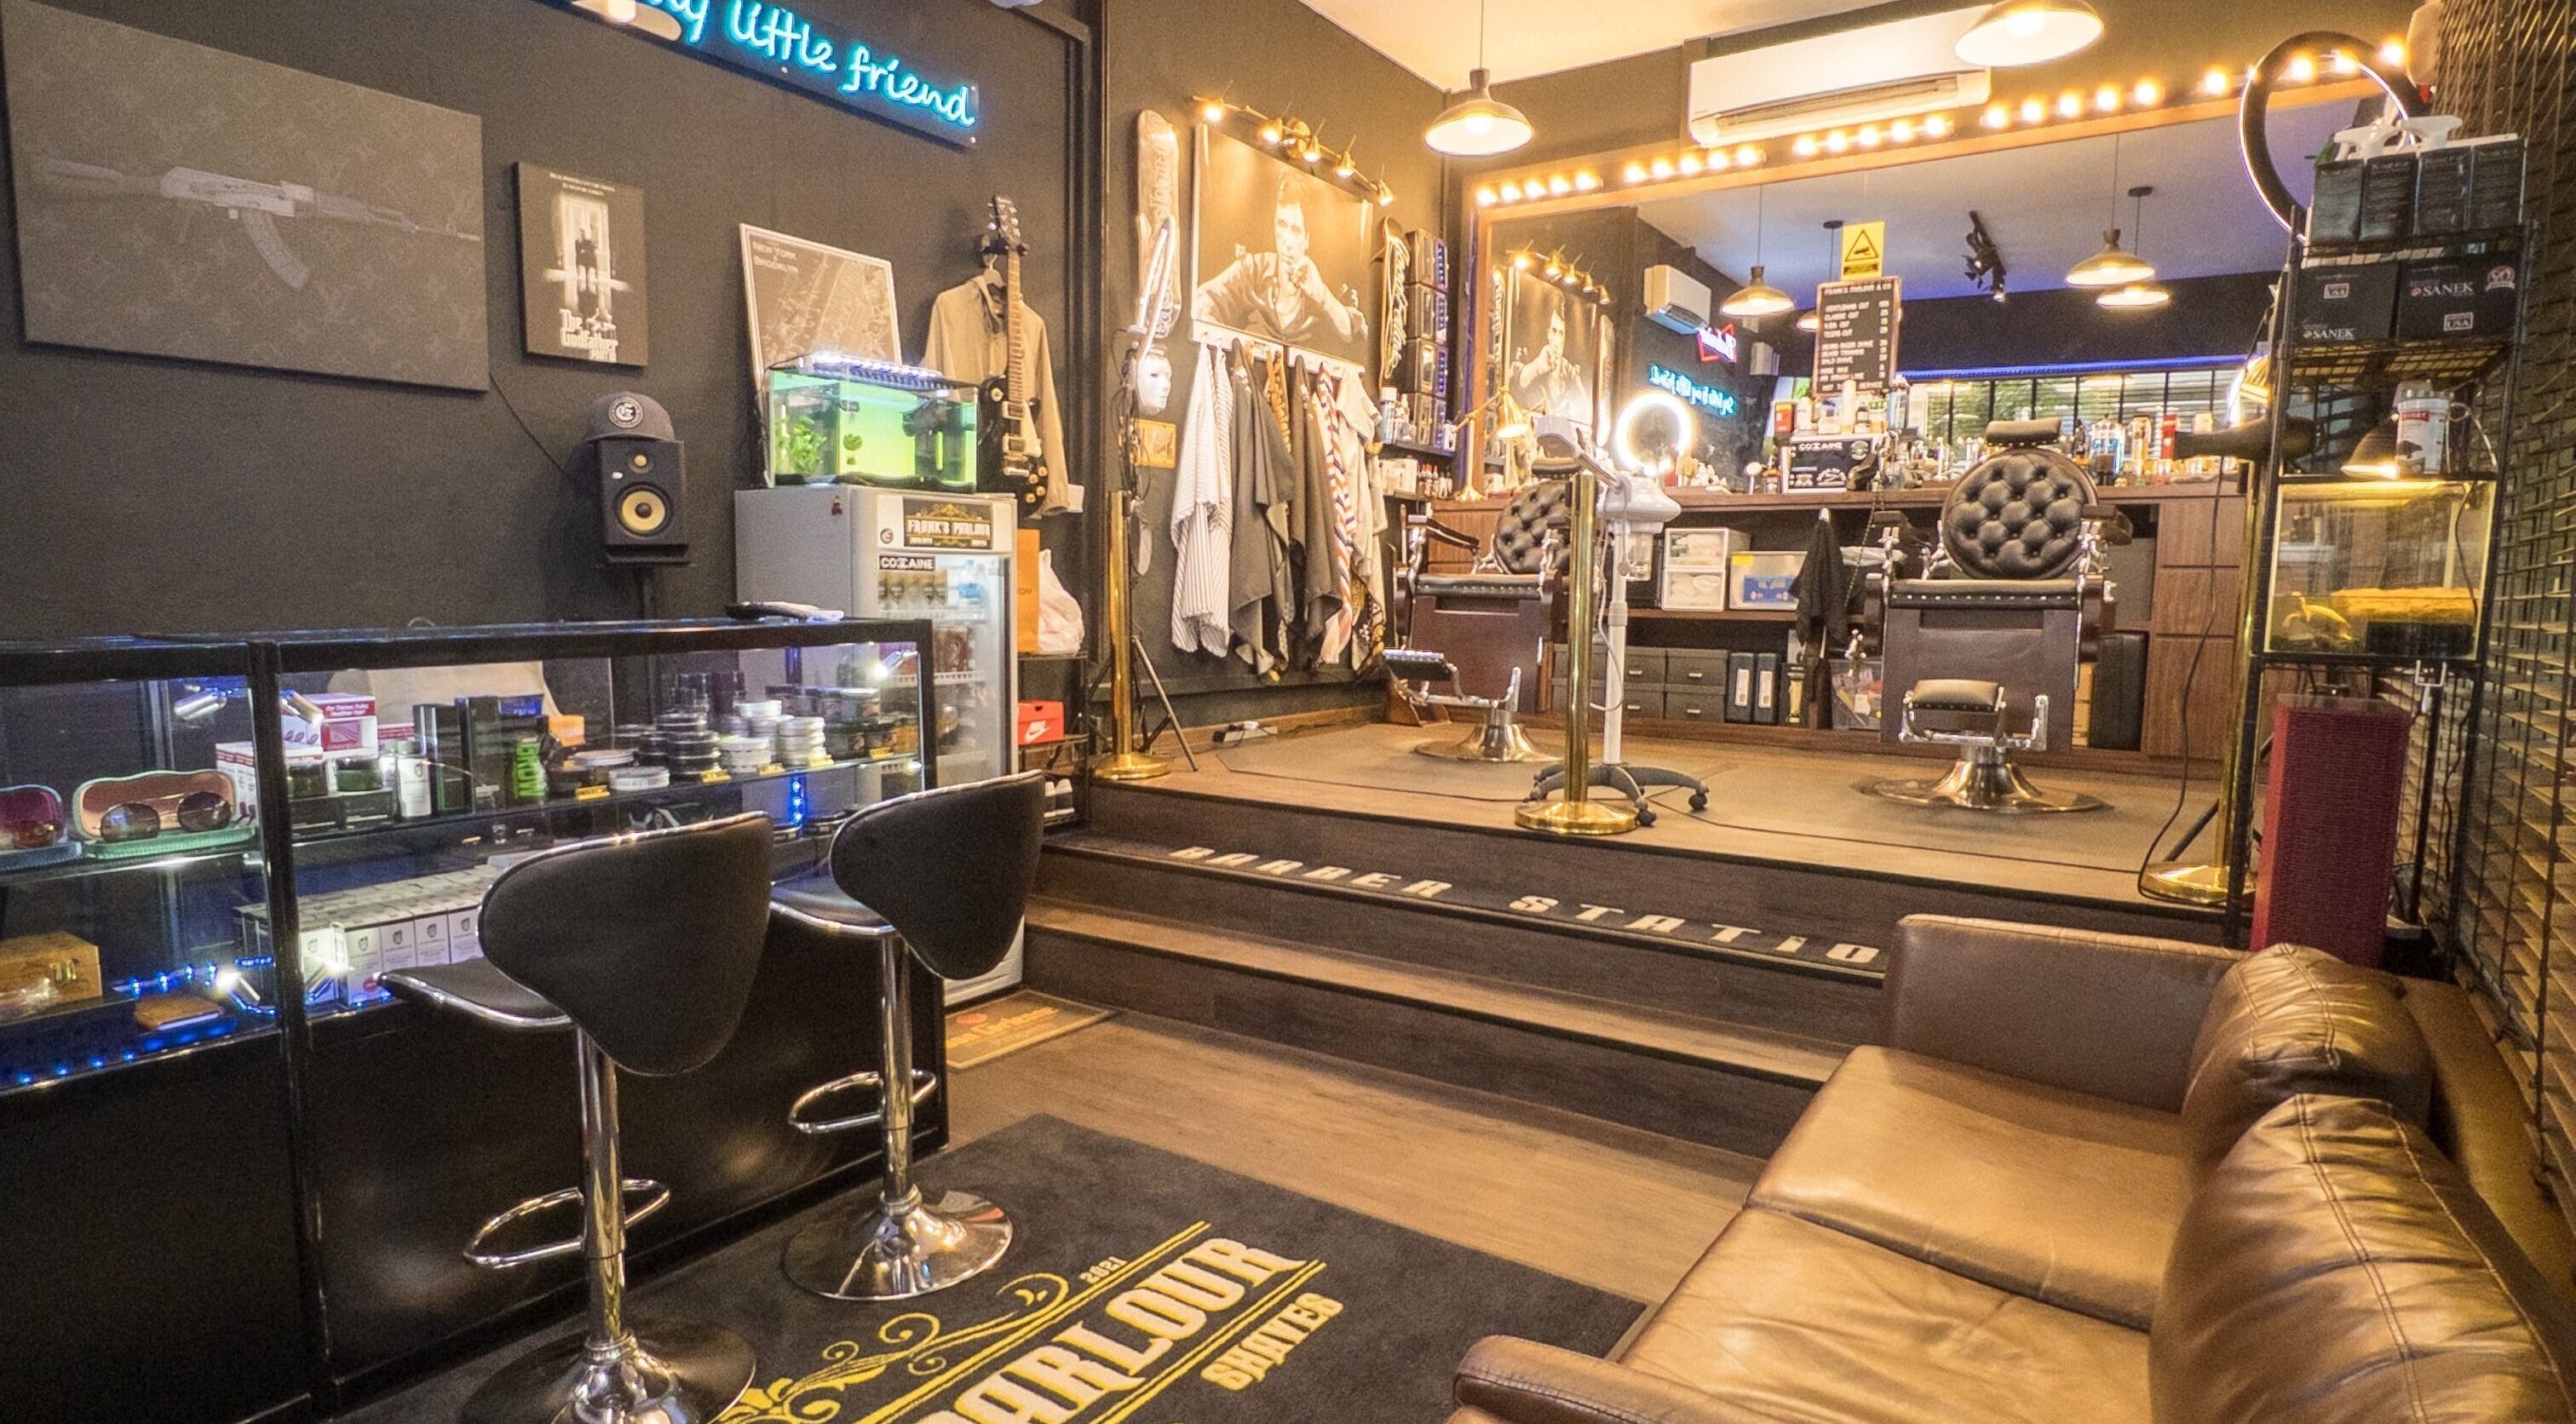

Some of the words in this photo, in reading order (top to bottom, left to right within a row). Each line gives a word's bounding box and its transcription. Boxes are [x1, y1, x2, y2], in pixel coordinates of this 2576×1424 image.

[732, 0, 837, 71] little
[841, 46, 976, 126] friend
[2312, 328, 2355, 340] SANEK
[2423, 283, 2475, 296] SANEK
[1169, 846, 1452, 897] BARBER
[1509, 894, 1880, 964] STATIO
[1079, 1255, 1128, 1283] 2021
[913, 1237, 1307, 1424] ARLOUR
[1199, 1293, 1344, 1391] SHAVES
